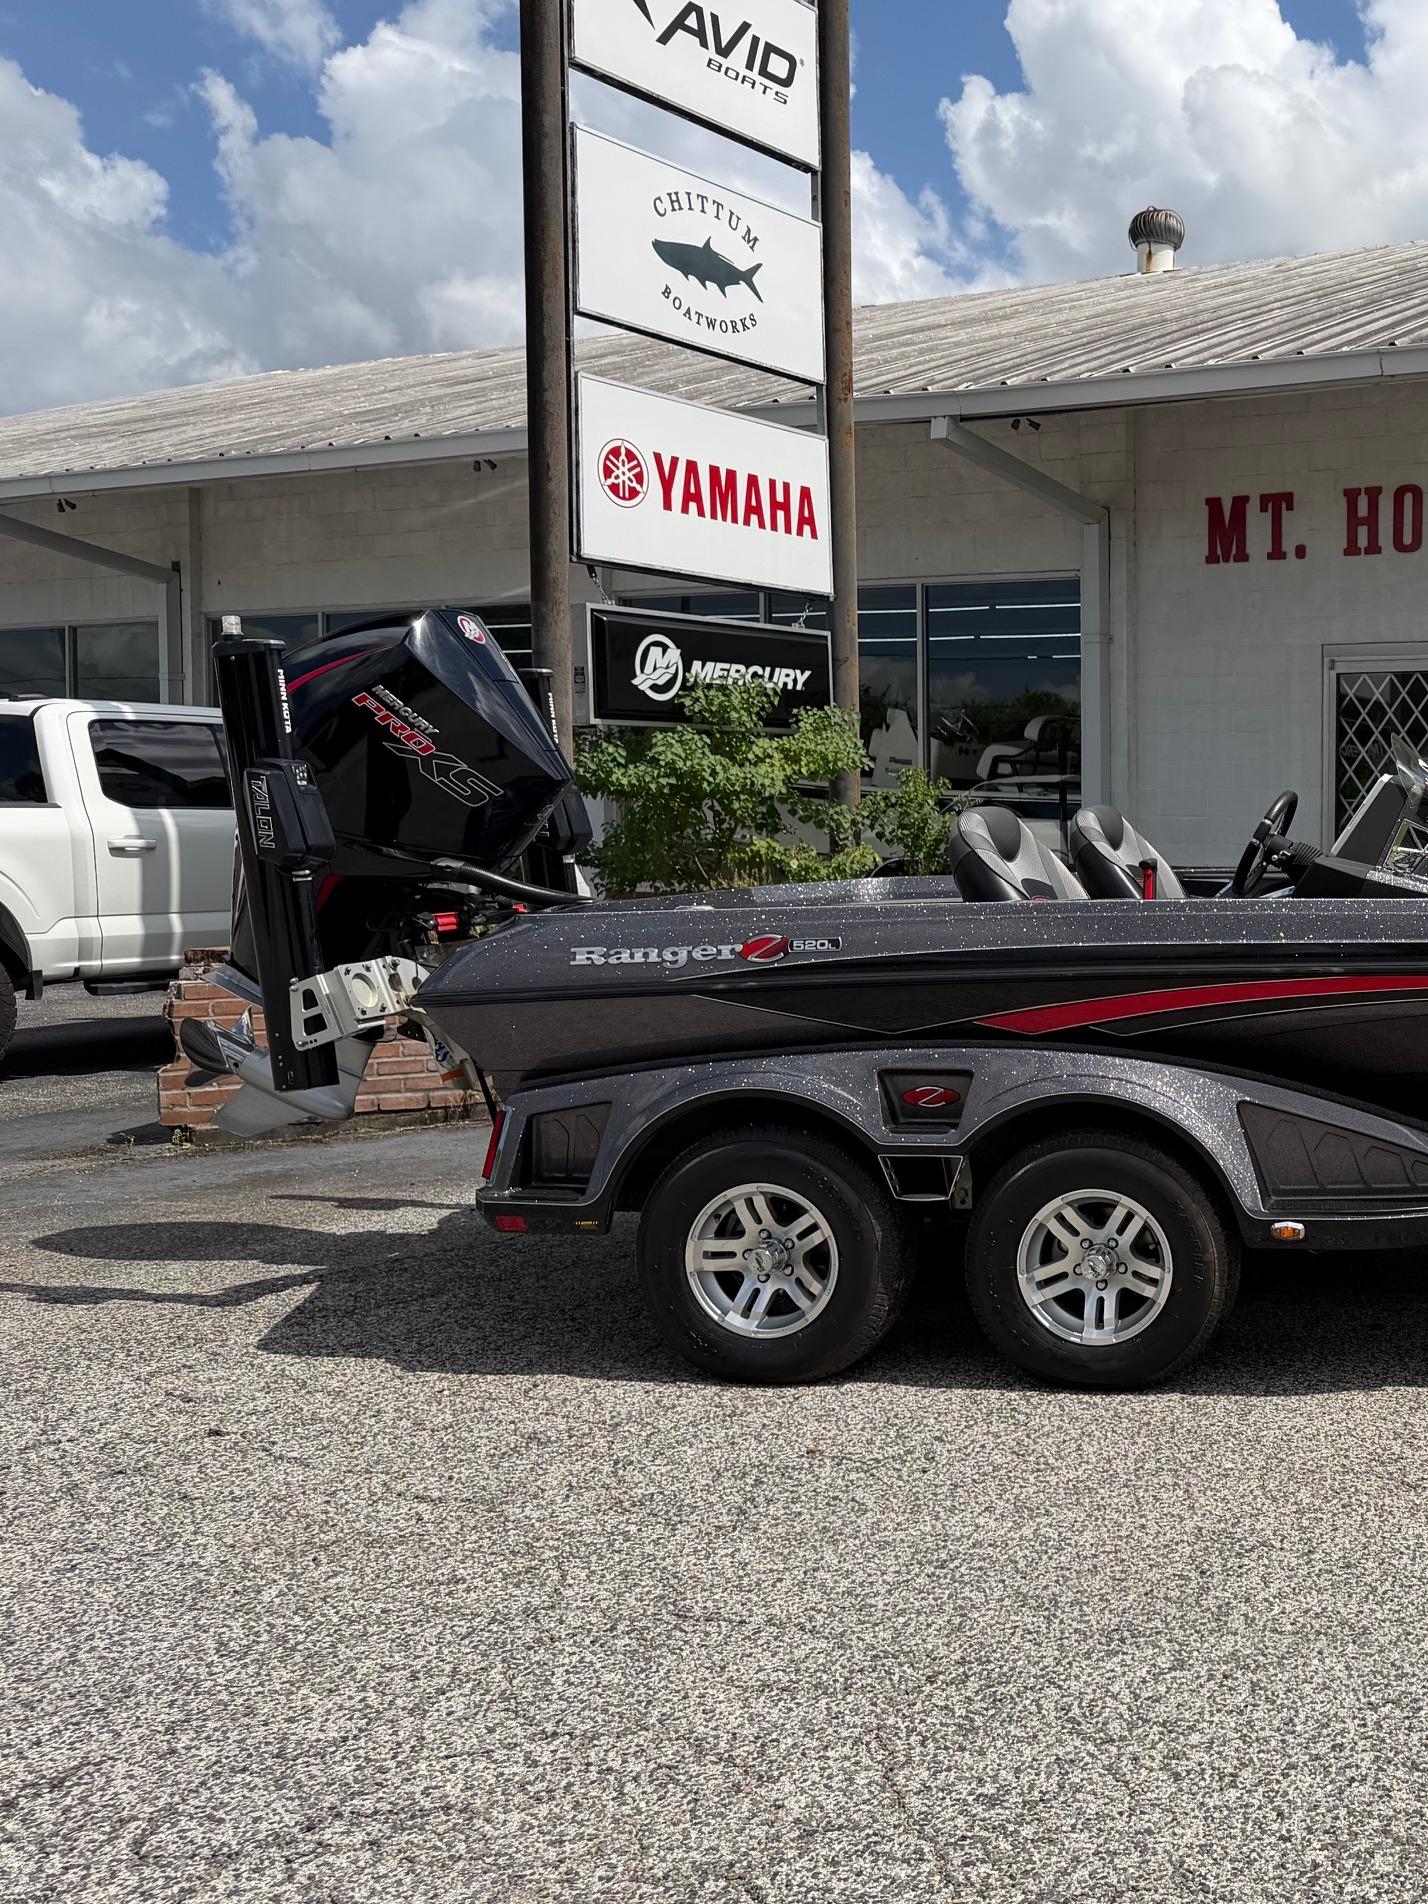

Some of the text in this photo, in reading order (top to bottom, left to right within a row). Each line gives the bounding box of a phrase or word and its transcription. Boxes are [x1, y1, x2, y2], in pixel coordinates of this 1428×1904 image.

[655, 1, 798, 89] AVID
[706, 56, 789, 105] BOATS
[653, 191, 760, 253] CHITTUM
[660, 283, 758, 334] BOATWORKS
[652, 451, 819, 541] YAMAHA
[1205, 491, 1307, 565] MT.
[372, 685, 440, 735] MERCURY
[351, 692, 505, 807] PRO XS
[251, 776, 276, 849] TALON
[569, 943, 743, 968] Ranger
